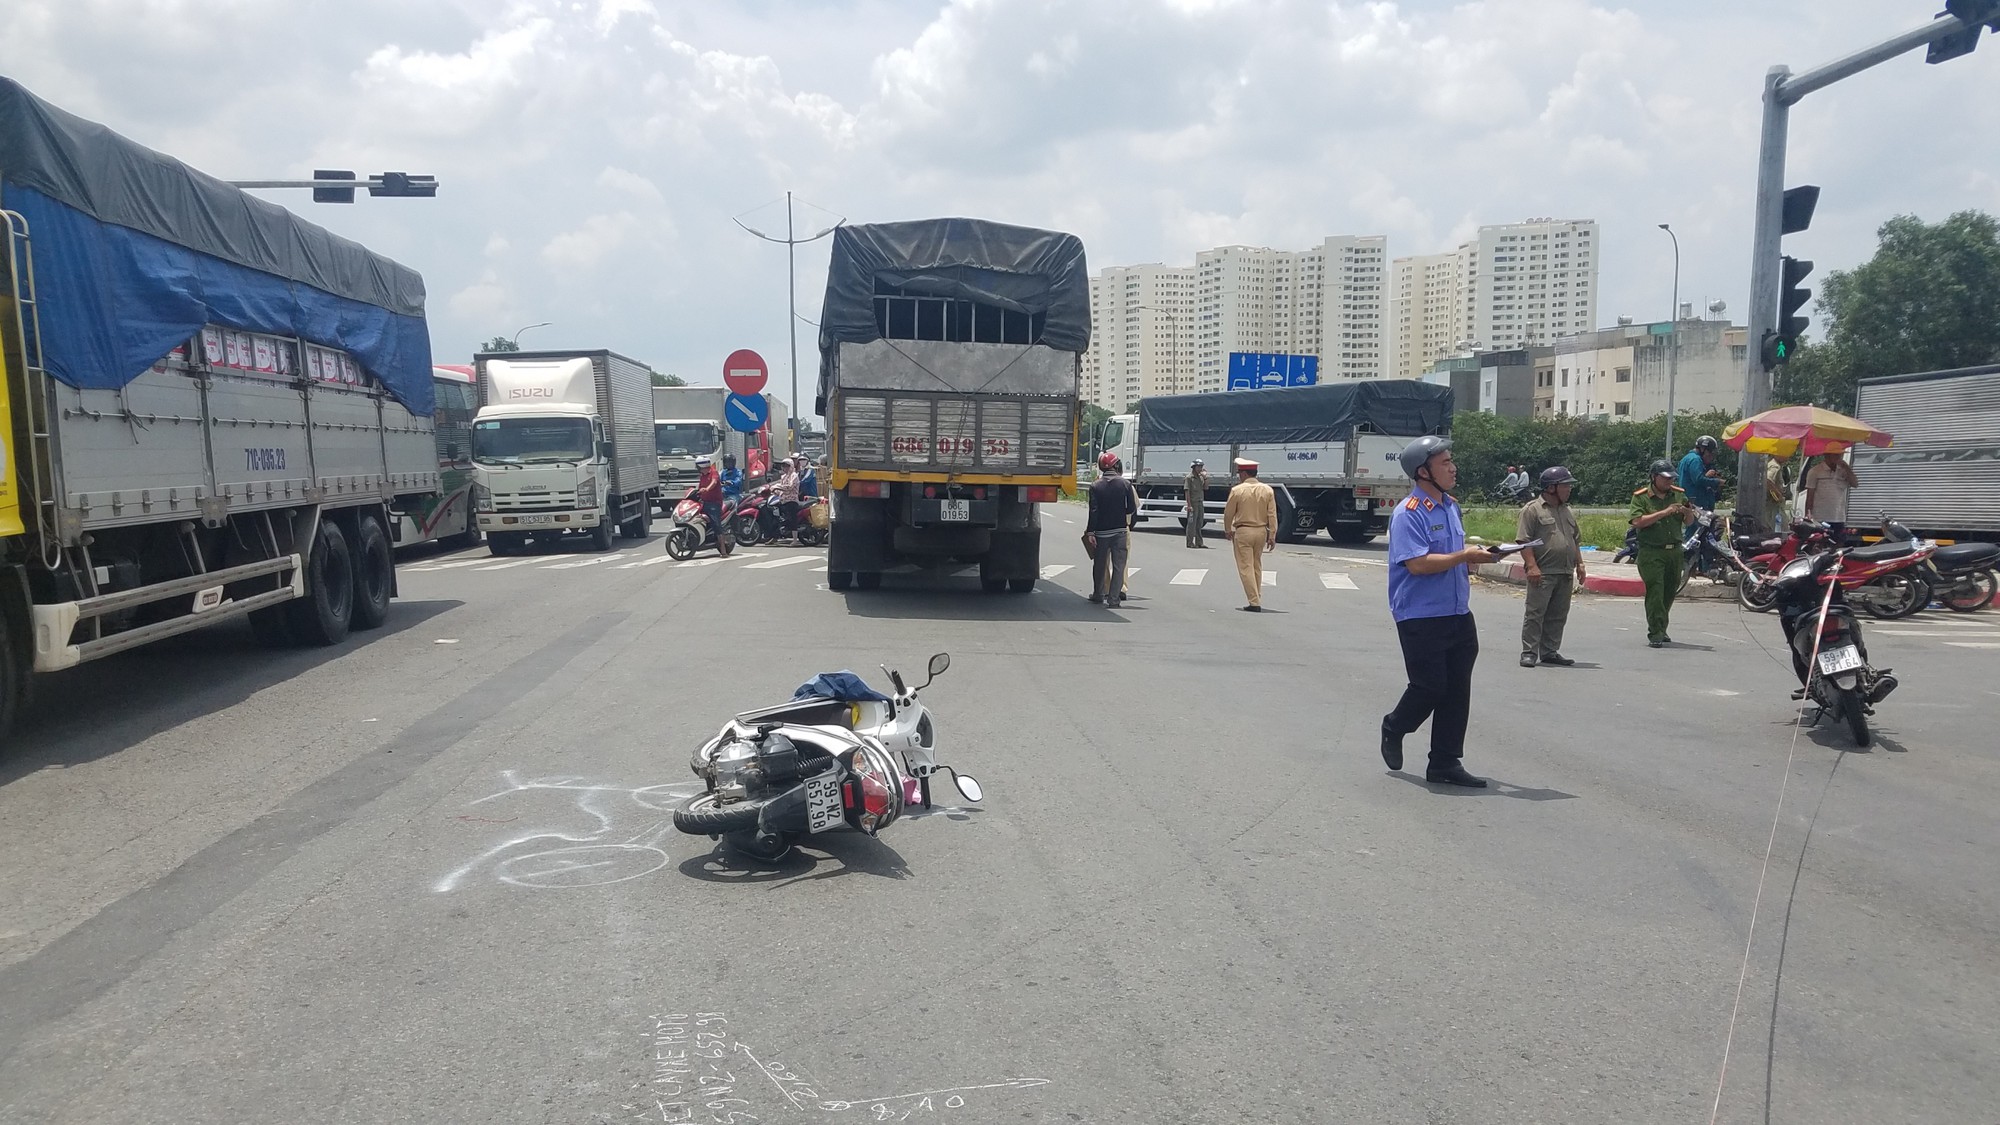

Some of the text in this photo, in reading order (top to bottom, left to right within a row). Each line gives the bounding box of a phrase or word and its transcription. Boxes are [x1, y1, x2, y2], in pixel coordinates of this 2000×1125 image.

[508, 388, 554, 399] ISUZU
[893, 437, 1009, 455] 68C 019 53
[245, 448, 286, 470] 71C-035.23
[947, 501, 963, 511] 68C
[942, 511, 968, 520] 019.53
[807, 780, 827, 829] 652.98
[823, 780, 841, 821] 59-N2
